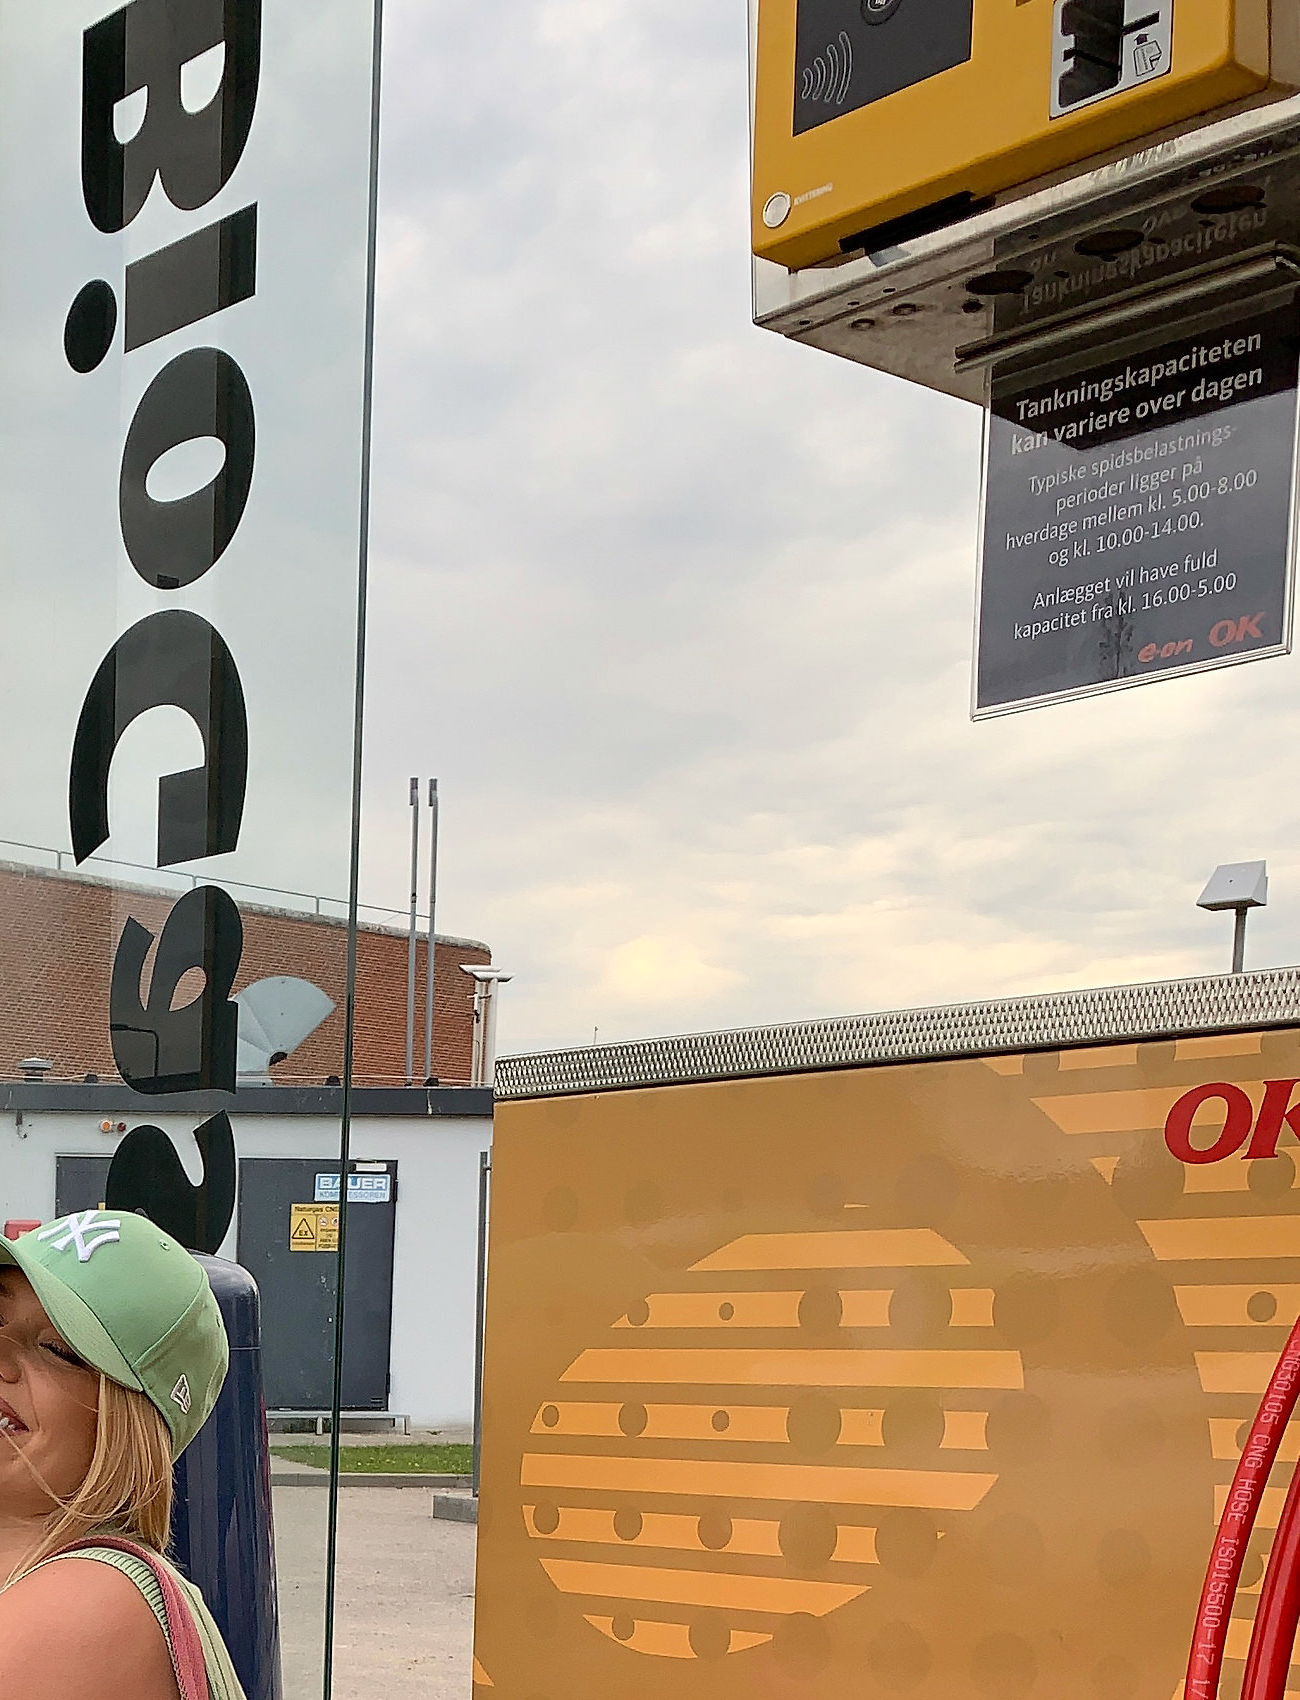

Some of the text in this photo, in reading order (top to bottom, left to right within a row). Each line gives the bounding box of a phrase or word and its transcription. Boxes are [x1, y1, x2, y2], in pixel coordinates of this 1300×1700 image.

[1016, 333, 1261, 420] Tankningskapaciteten
[1011, 367, 1262, 455] kan variere over dagen
[1028, 425, 1237, 496] Typiske spidsbelastnings-
[1055, 456, 1203, 517] perioder ligger på
[1006, 469, 1258, 550] hverdage mellem kl. 5.00-8.00
[1048, 511, 1204, 567] og kl. 10.00-14.00.
[1014, 572, 1237, 640] kapacitet fra kl. 16.00-5.00
[1032, 548, 1217, 610] Anlægget vil have fuld
[1208, 610, 1266, 648] OK
[1164, 1079, 1300, 1164] OK
[1245, 1433, 1271, 1469] CNG
[1227, 1478, 1257, 1524] HOSE
